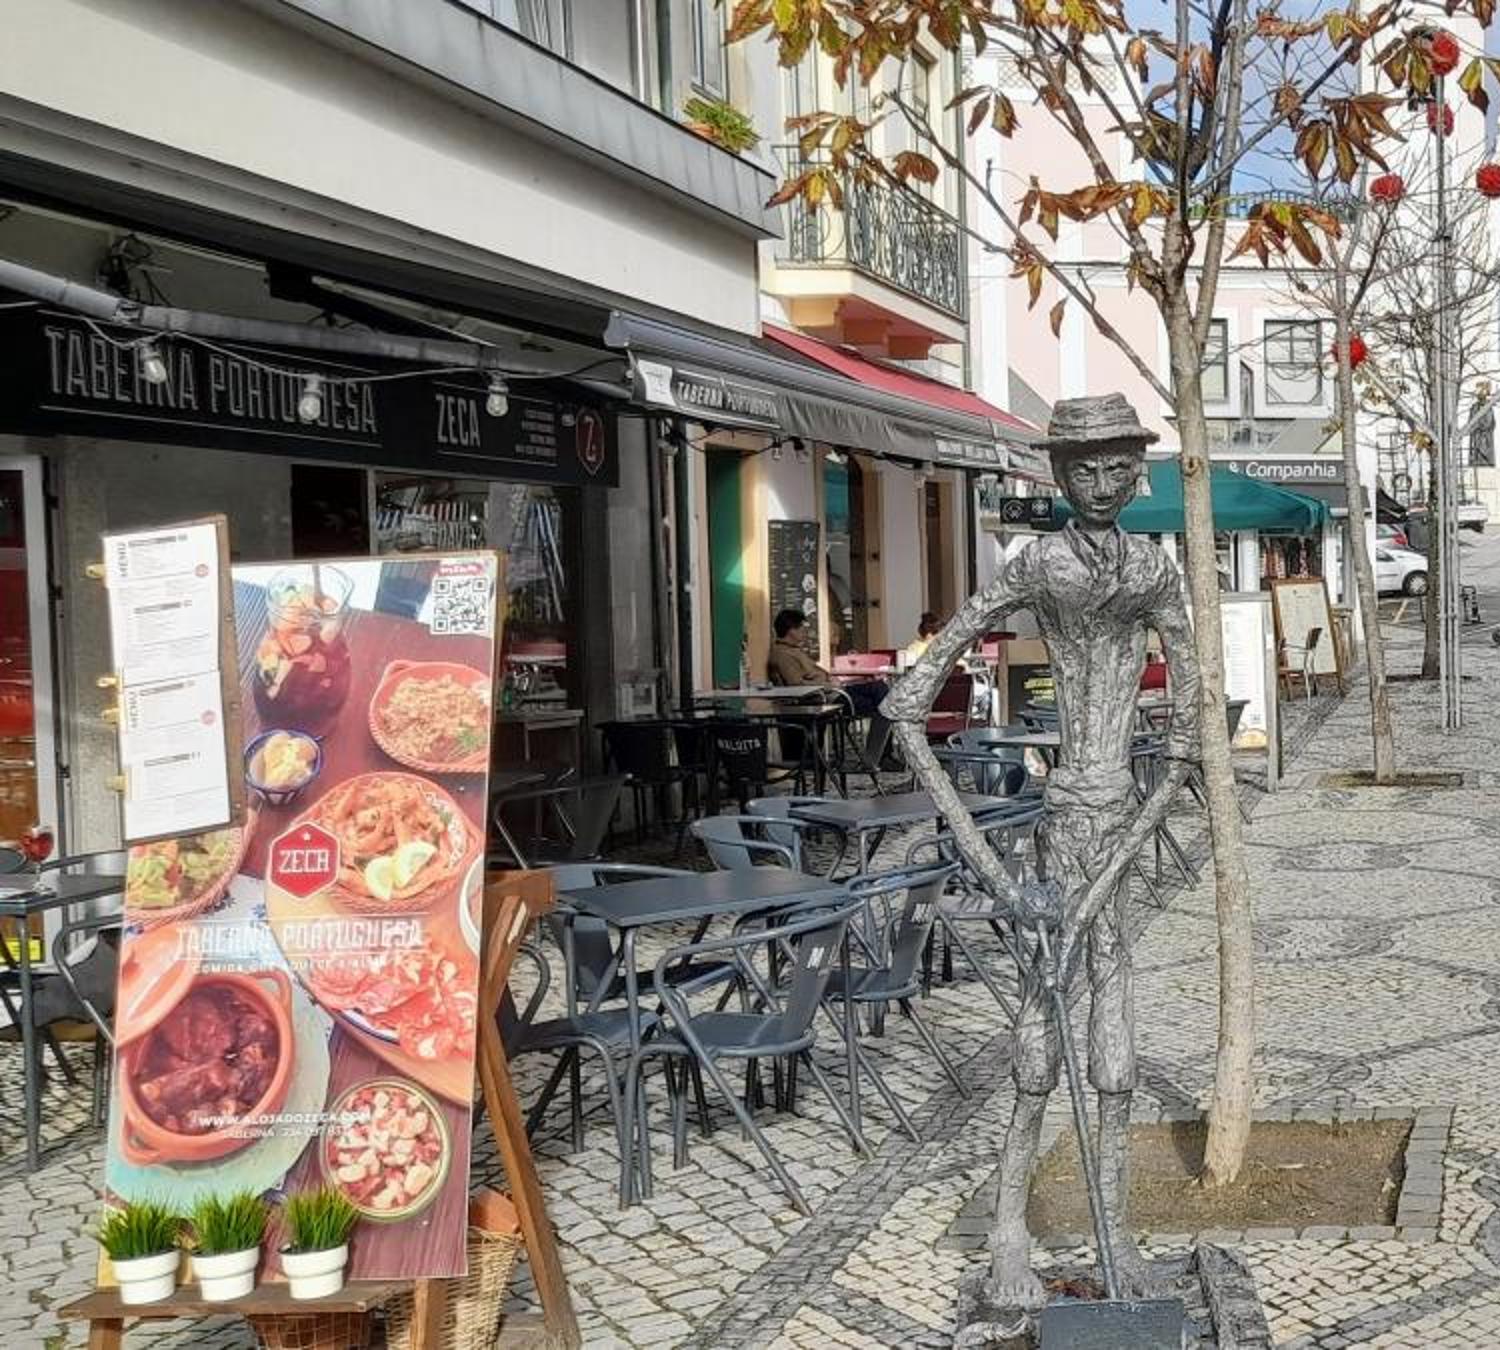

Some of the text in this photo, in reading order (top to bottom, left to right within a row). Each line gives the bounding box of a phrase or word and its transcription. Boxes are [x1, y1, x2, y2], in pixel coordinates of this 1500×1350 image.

[208, 354, 378, 434] PORTUUESA
[435, 392, 481, 448] ZECA
[1245, 461, 1337, 480] Companhia
[279, 848, 330, 874] ZECA
[175, 916, 425, 955] TABERNA PORTUGUESA
